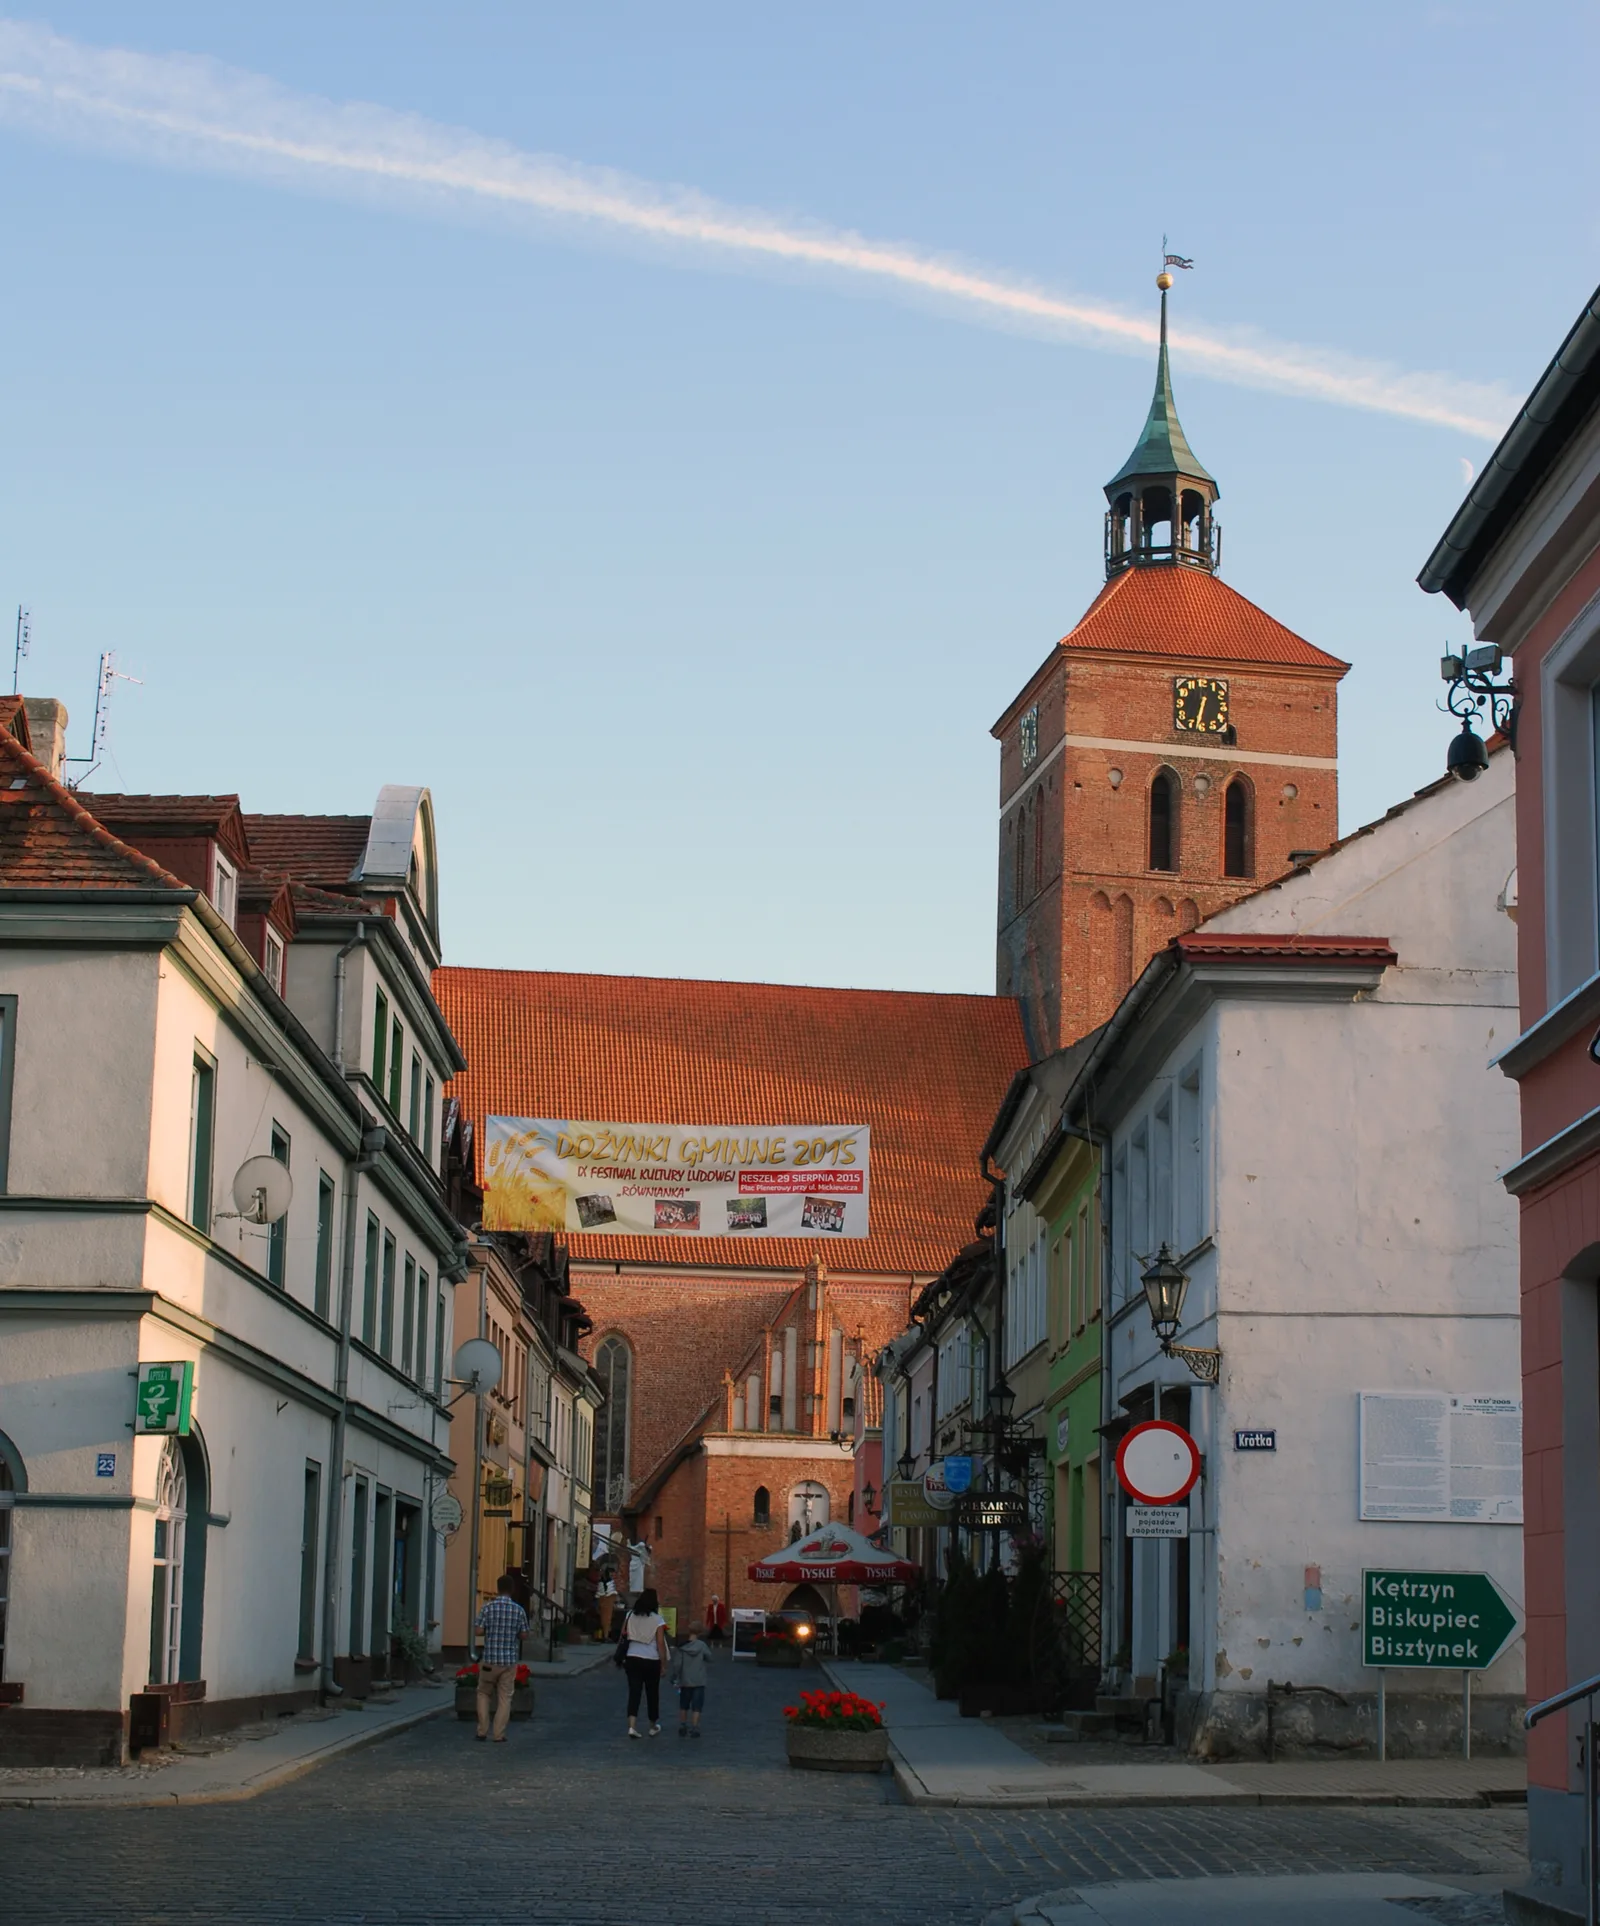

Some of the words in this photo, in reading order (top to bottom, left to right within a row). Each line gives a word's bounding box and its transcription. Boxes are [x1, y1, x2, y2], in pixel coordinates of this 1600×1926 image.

[1187, 680, 1195, 690] 11
[1197, 679, 1208, 688] 12
[1210, 681, 1216, 692] 1
[1178, 687, 1189, 697] 10
[1217, 690, 1225, 701] 2
[1176, 698, 1184, 709] 9
[1219, 701, 1228, 712] 3
[1178, 709, 1186, 720] 8
[1217, 712, 1226, 723] 4
[1187, 718, 1195, 729] 7
[1198, 721, 1206, 732] 6
[1208, 719, 1217, 730] 5
[556, 1129, 671, 1162] DOŻYNKI
[679, 1136, 786, 1168] GMINNE
[793, 1137, 857, 1166] 2015
[577, 1166, 588, 1178] IX
[590, 1166, 637, 1180] FESTIWAL
[640, 1167, 685, 1182] KULTURY
[687, 1169, 736, 1183] LUDOWEJ
[740, 1174, 775, 1183] RESZEL
[777, 1174, 790, 1183] 29
[792, 1173, 835, 1183] SIERPNIA
[836, 1173, 860, 1183] 2015
[756, 1184, 792, 1193] Plenerowy
[792, 1185, 807, 1193] przy
[1238, 1433, 1273, 1447] Krótka
[98, 1459, 114, 1471] 23
[960, 1501, 1024, 1511] PIEKARNIA
[1134, 1509, 1148, 1517] Nie
[1150, 1508, 1180, 1518] dotyczy
[958, 1515, 1022, 1525] CUKIERNIA
[1138, 1517, 1176, 1527] pojazdów
[1132, 1526, 1182, 1535] zaopatrzenia
[755, 1567, 775, 1579] TYSKIE
[800, 1566, 837, 1579] TYSKIE
[865, 1566, 897, 1578] TYSKIE
[1371, 1577, 1455, 1604] Kętrzyn
[1371, 1606, 1480, 1633] Biskupiec
[1371, 1635, 1479, 1664] Bisztynek
